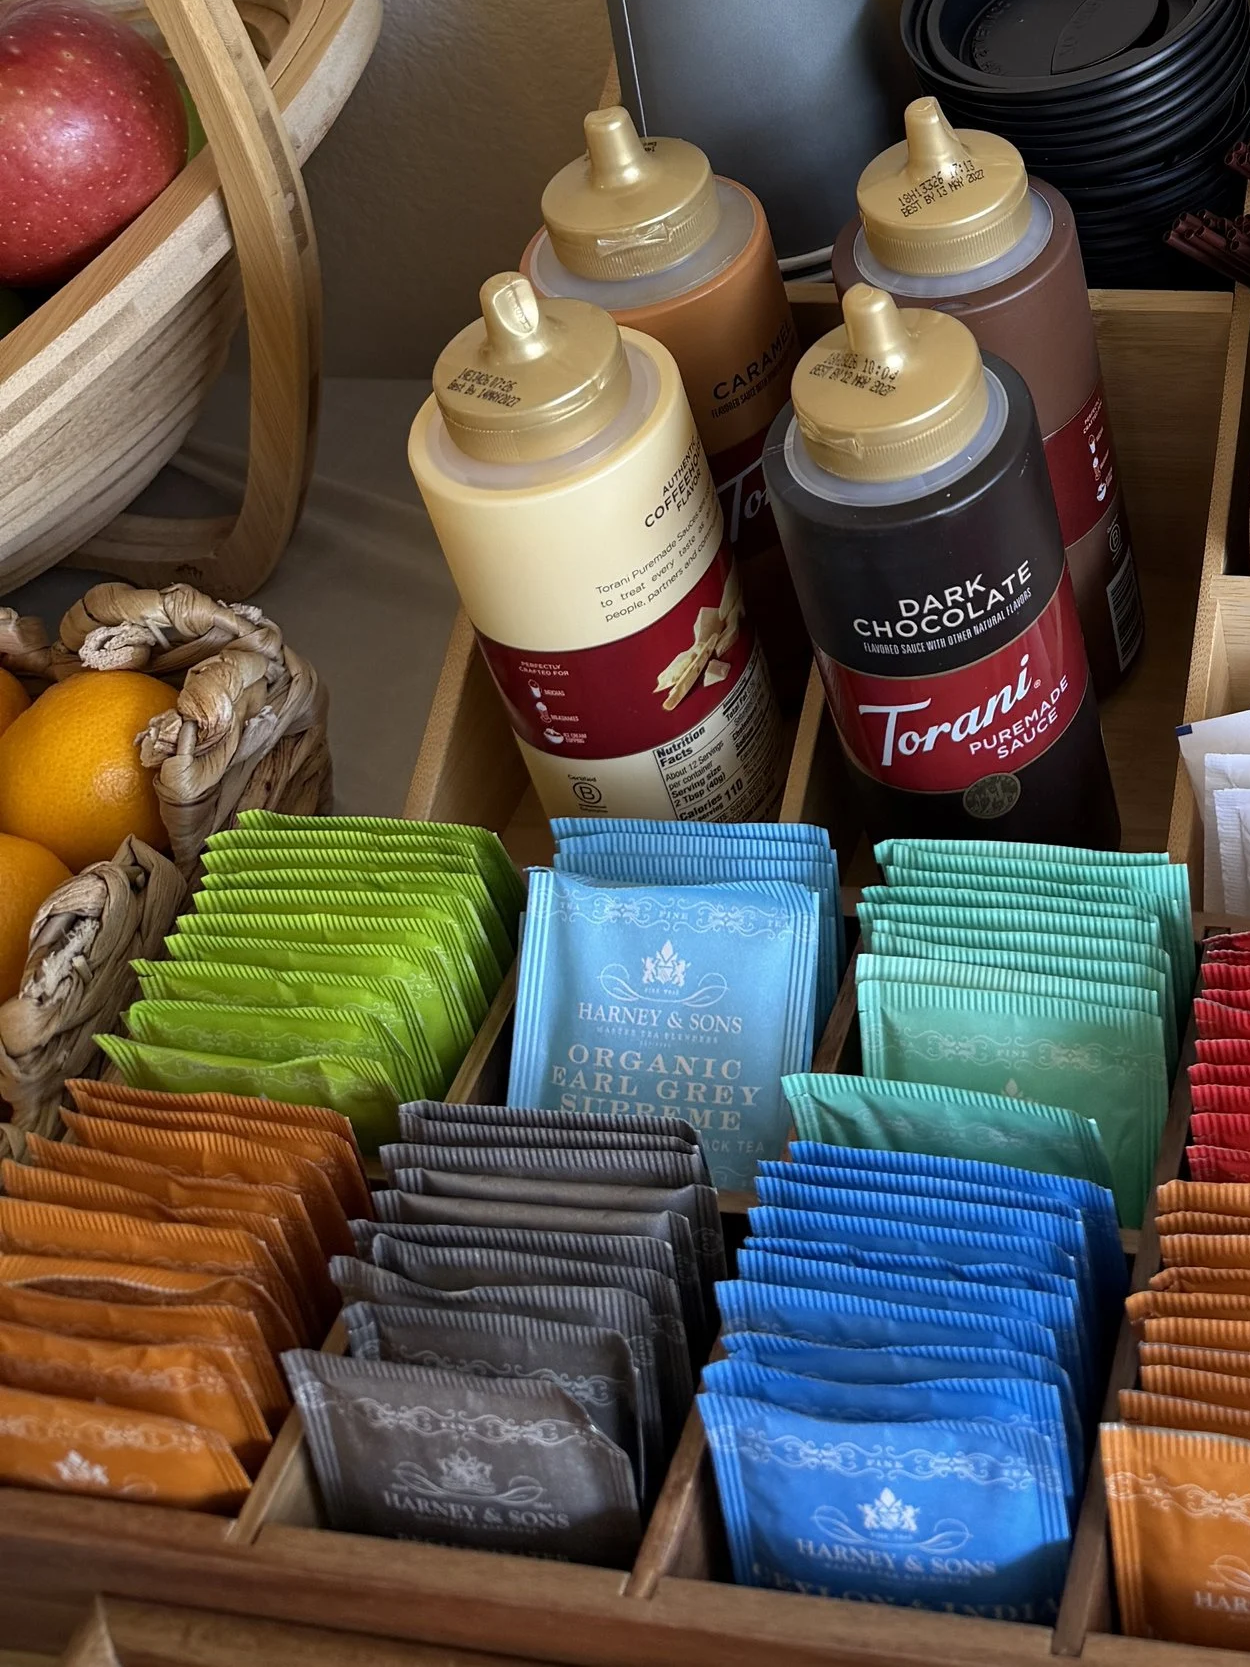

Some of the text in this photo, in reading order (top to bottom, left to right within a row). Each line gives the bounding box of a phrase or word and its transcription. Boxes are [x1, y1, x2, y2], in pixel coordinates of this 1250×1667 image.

[901, 200, 922, 218] BEST
[924, 192, 935, 204] BY
[948, 176, 964, 192] MAY
[713, 321, 791, 399] CARAMEL
[596, 576, 631, 595] Torani
[632, 540, 676, 579] Puremade
[677, 511, 699, 541] Sauces
[601, 599, 613, 608] to
[620, 582, 646, 601] treat
[652, 559, 675, 582] every
[679, 535, 695, 557] taste
[648, 567, 683, 602] partners
[685, 549, 697, 569] and
[898, 573, 986, 617] DARK
[853, 560, 1032, 638] CHOCOLATE
[864, 587, 1032, 655] FLAVORED SAUCE WITH OTHER NATURAL FLAVORS
[858, 653, 1032, 767] Torani
[969, 675, 1069, 755] PUREMADE
[656, 726, 706, 758] Nutrition
[997, 707, 1058, 759] SAUCE
[660, 747, 693, 768] Facts
[666, 740, 724, 782] About 12 Servings
[669, 760, 713, 792] per container
[672, 765, 722, 799] Serving size
[674, 771, 726, 807] 2 Tbsp (40g)
[679, 794, 722, 821] Calories
[724, 778, 744, 801] 110
[659, 910, 690, 920] FINE
[578, 1002, 742, 1034] HARNEY & SONS
[568, 1044, 743, 1080] ORGANIC
[552, 1065, 763, 1106] EARL GREY
[703, 1139, 765, 1153] ACK TEA
[383, 1490, 475, 1520] HARNEY
[483, 1507, 502, 1524] &
[508, 1510, 570, 1529] SONS
[796, 1538, 897, 1569] HARNEY
[903, 1555, 925, 1573] &
[932, 1558, 997, 1577] SONS
